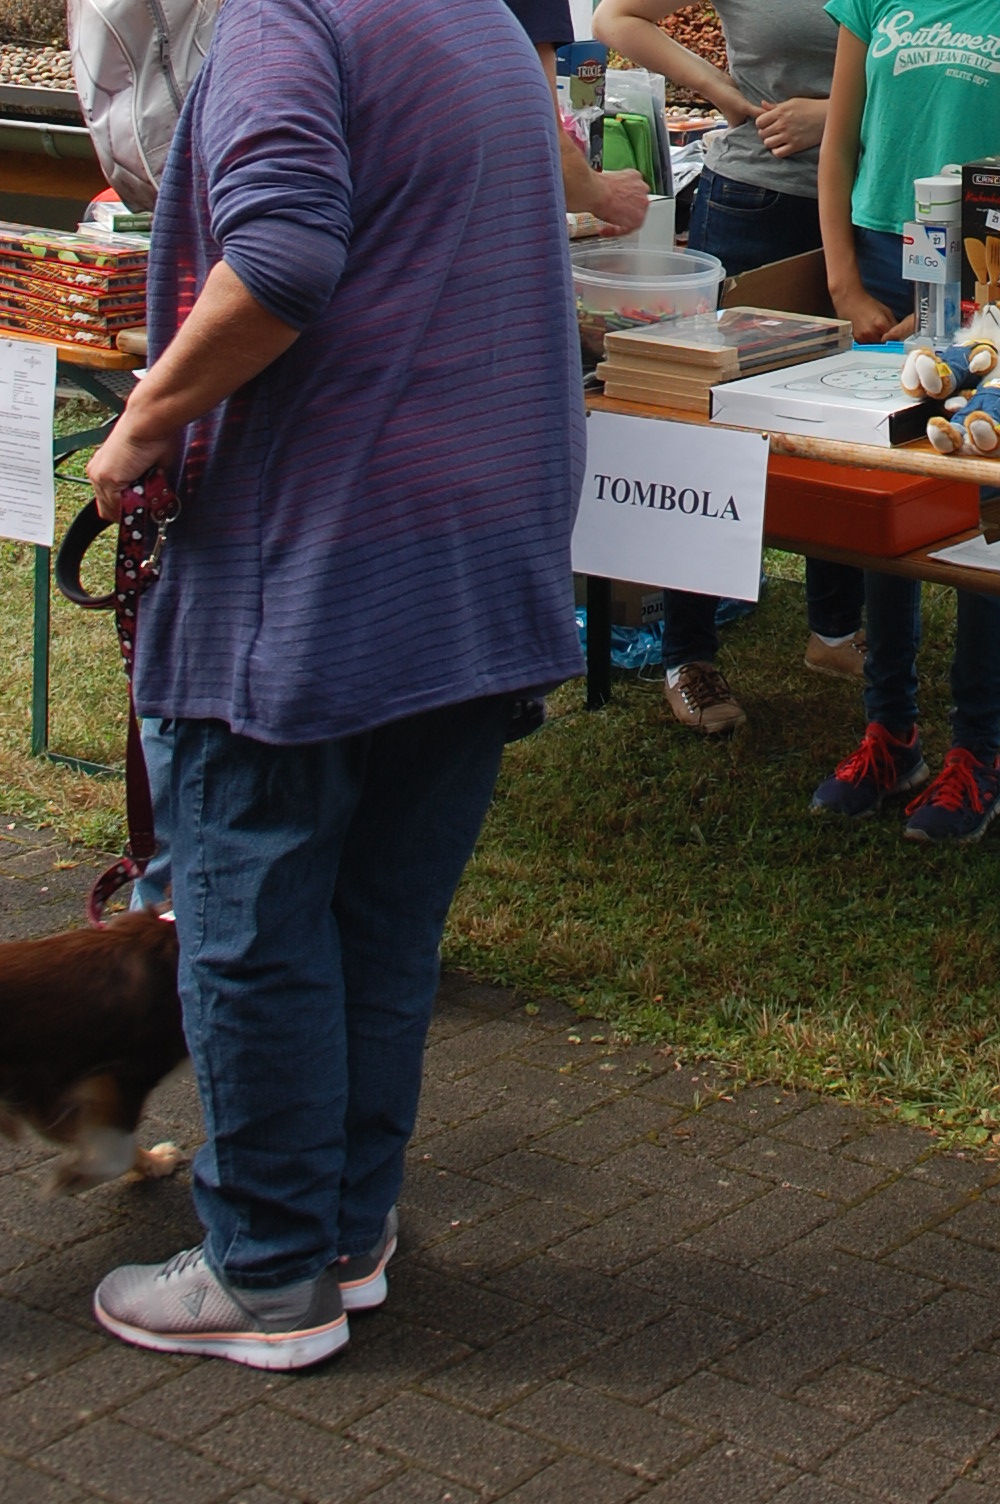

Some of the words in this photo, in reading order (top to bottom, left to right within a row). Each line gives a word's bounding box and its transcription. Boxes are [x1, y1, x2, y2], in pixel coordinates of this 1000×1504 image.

[577, 64, 603, 78] TRIXIE
[898, 51, 931, 68] SAINT
[935, 50, 957, 63] JEAN
[960, 53, 973, 65] DE
[975, 55, 993, 70] LUZ
[920, 296, 929, 329] BRITA
[593, 474, 741, 521] TOMBOLA
